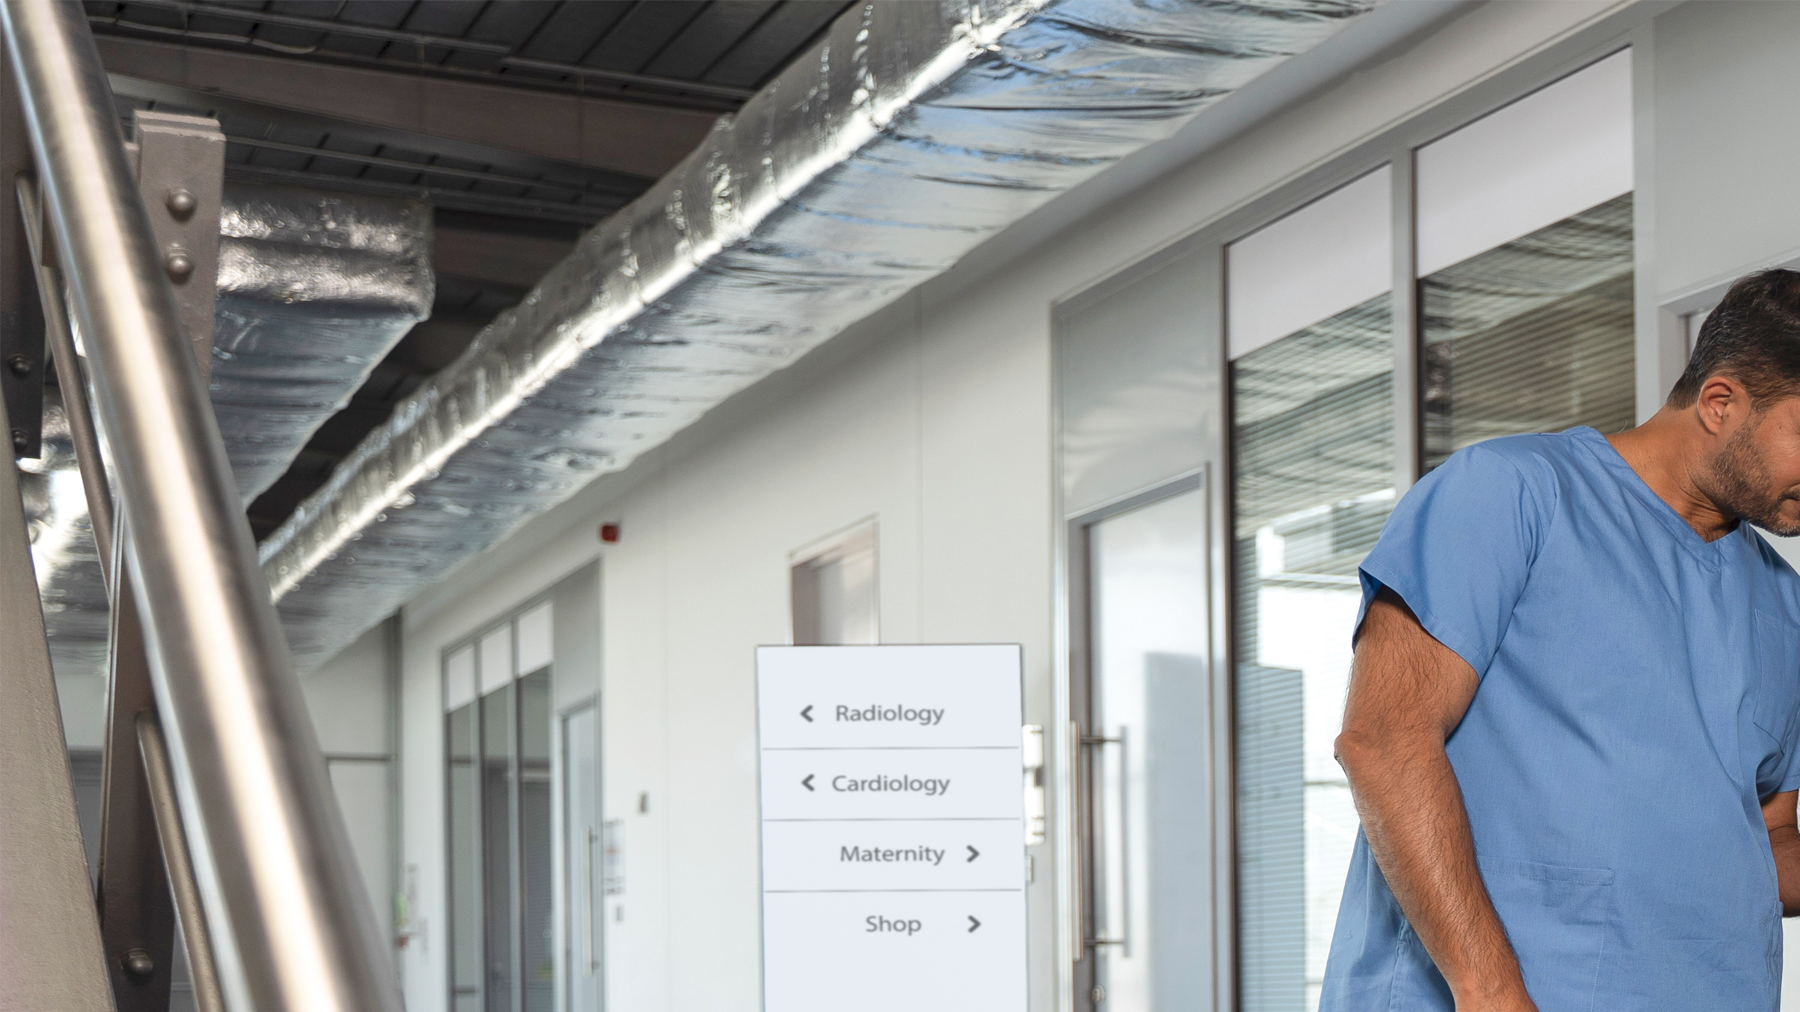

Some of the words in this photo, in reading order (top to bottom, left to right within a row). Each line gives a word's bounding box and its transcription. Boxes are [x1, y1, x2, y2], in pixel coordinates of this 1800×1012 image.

[835, 703, 945, 726] Radiology
[831, 774, 951, 797] Cardiology
[839, 845, 946, 867] Maternity
[865, 914, 923, 937] Shop
